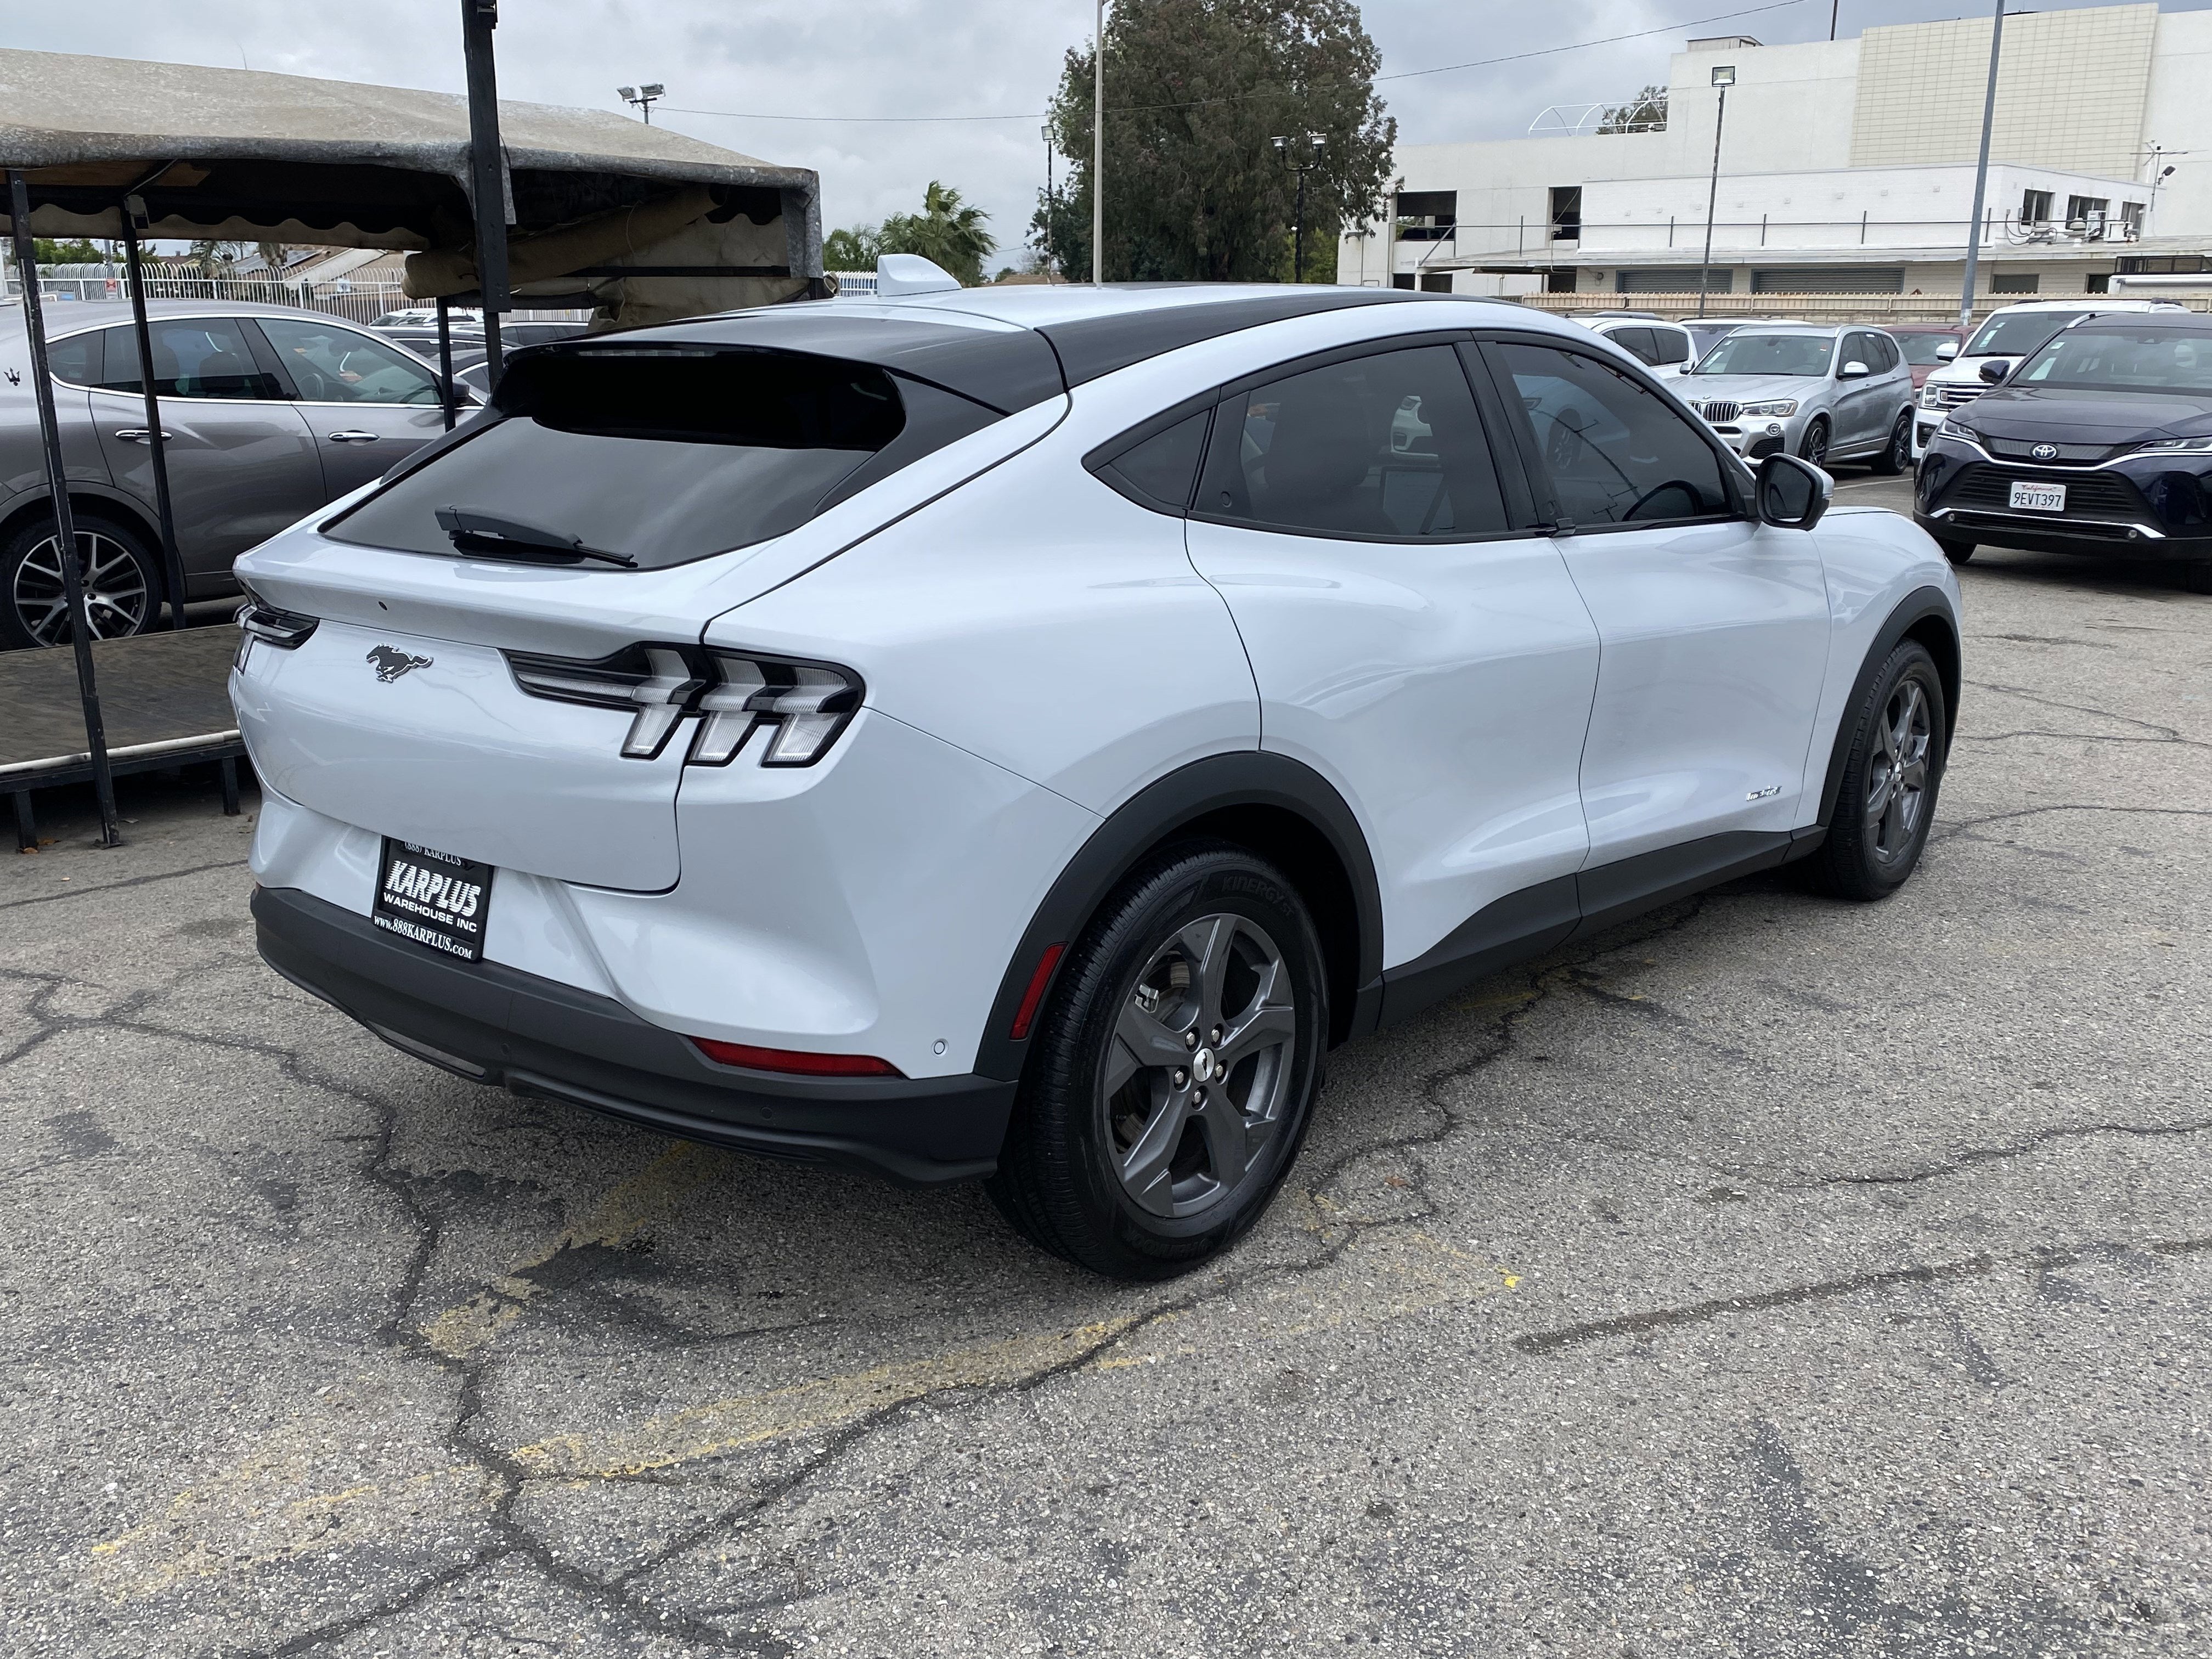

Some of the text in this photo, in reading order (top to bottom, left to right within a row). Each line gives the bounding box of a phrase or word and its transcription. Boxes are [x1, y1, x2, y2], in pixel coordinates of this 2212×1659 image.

[2013, 492, 2062, 507] 9EVT397
[424, 848, 461, 866] KARPLUS
[385, 860, 481, 917] KARPLUS
[383, 892, 477, 933] WAREHOUSE INC
